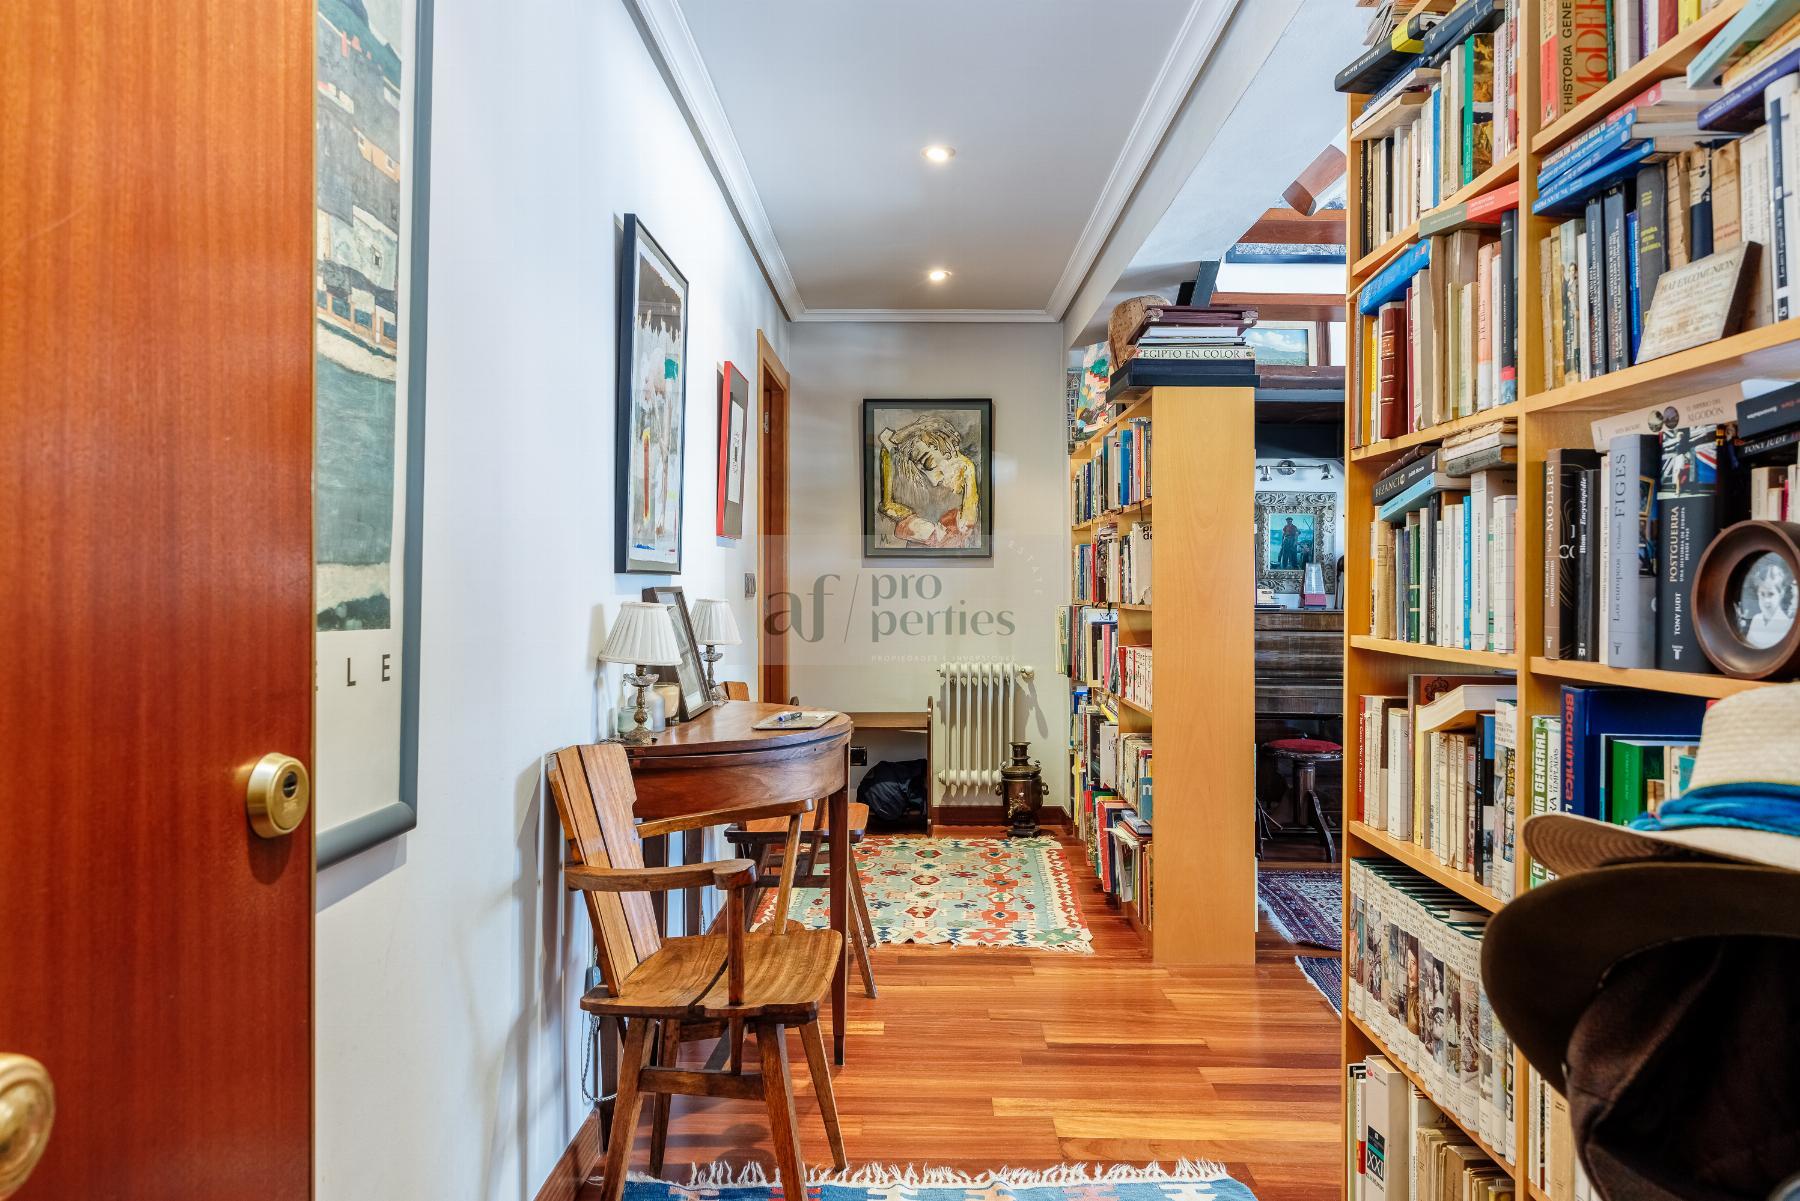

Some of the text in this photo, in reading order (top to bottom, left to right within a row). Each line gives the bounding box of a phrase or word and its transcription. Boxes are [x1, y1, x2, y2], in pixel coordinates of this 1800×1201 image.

[1562, 45, 1573, 105] HISTORIA
[1143, 349, 1240, 359] EGIPTO EN COLOR
[1744, 435, 1787, 454] TONY JUDT
[1546, 464, 1555, 532] MOLLER
[1615, 453, 1627, 518] FIGES
[1669, 506, 1680, 582] POSTGUERRA
[1615, 558, 1624, 601] europeos
[1674, 592, 1682, 613] JUDT
[1612, 603, 1620, 621] Los
[1535, 731, 1547, 792] GENERAL
